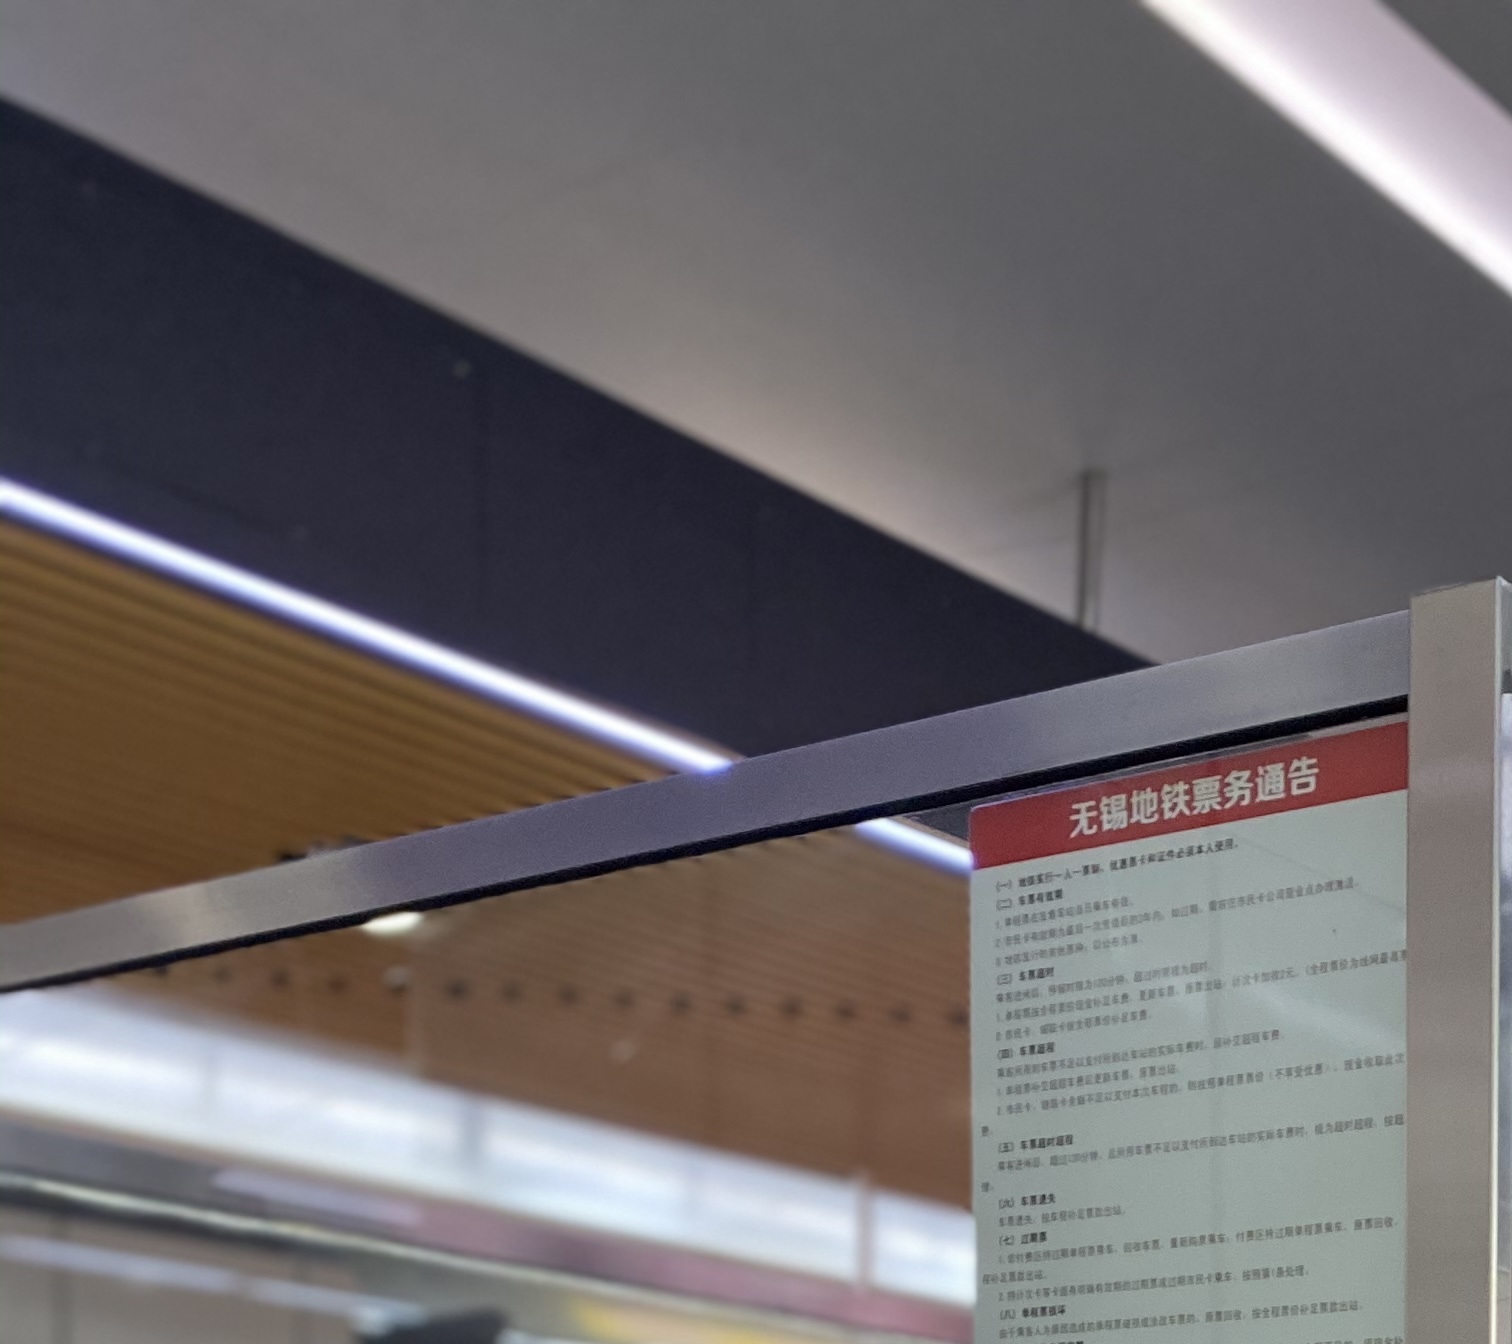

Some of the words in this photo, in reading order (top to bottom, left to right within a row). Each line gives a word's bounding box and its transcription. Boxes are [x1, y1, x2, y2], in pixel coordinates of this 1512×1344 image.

[1068, 756, 1320, 840] 无锡地铁票务通告
